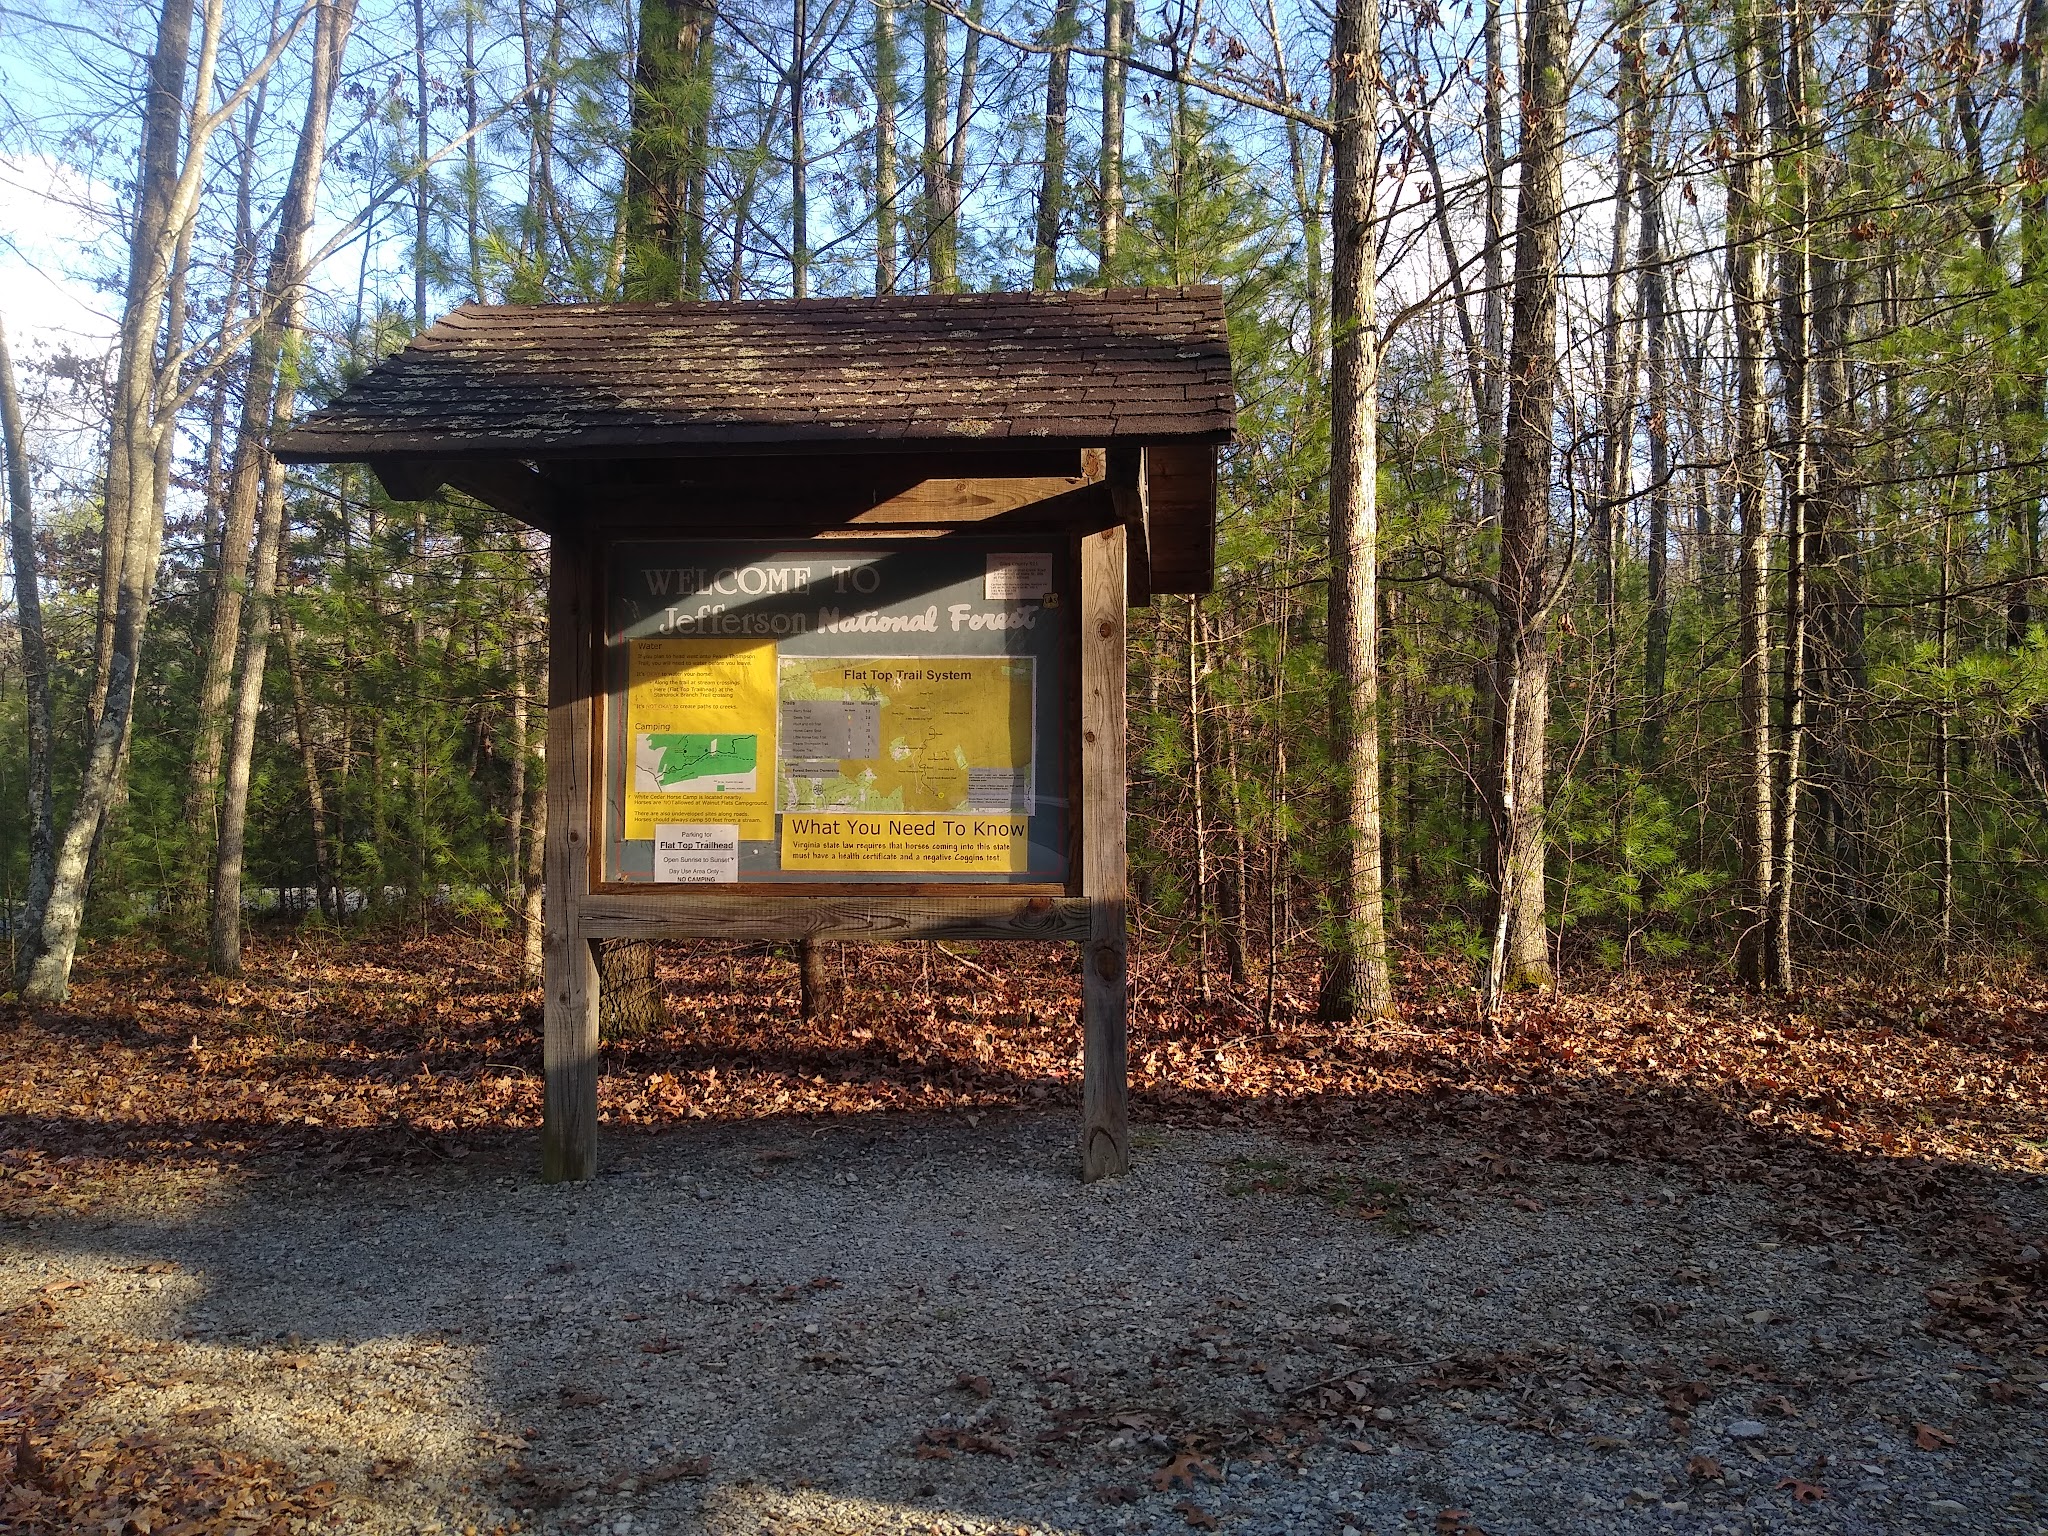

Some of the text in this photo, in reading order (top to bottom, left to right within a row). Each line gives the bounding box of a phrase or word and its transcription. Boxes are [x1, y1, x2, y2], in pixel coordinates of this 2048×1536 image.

[641, 566, 880, 595] WELCOME TO
[659, 603, 1040, 635] Jefferson National Forest
[844, 670, 971, 683] Flat Top Trail System
[635, 723, 670, 731] Camping
[792, 820, 1024, 837] What You Need To Know
[677, 842, 693, 850] Top
[695, 841, 734, 849] Trailhead
[793, 841, 821, 850] Virginia
[823, 841, 840, 849] state
[843, 841, 854, 849] law
[856, 842, 886, 851] requires
[906, 842, 929, 850] horses
[932, 844, 958, 852] coming
[960, 842, 974, 850] into
[977, 842, 991, 850] this
[923, 854, 951, 863] negative
[954, 854, 984, 863] Coggins
